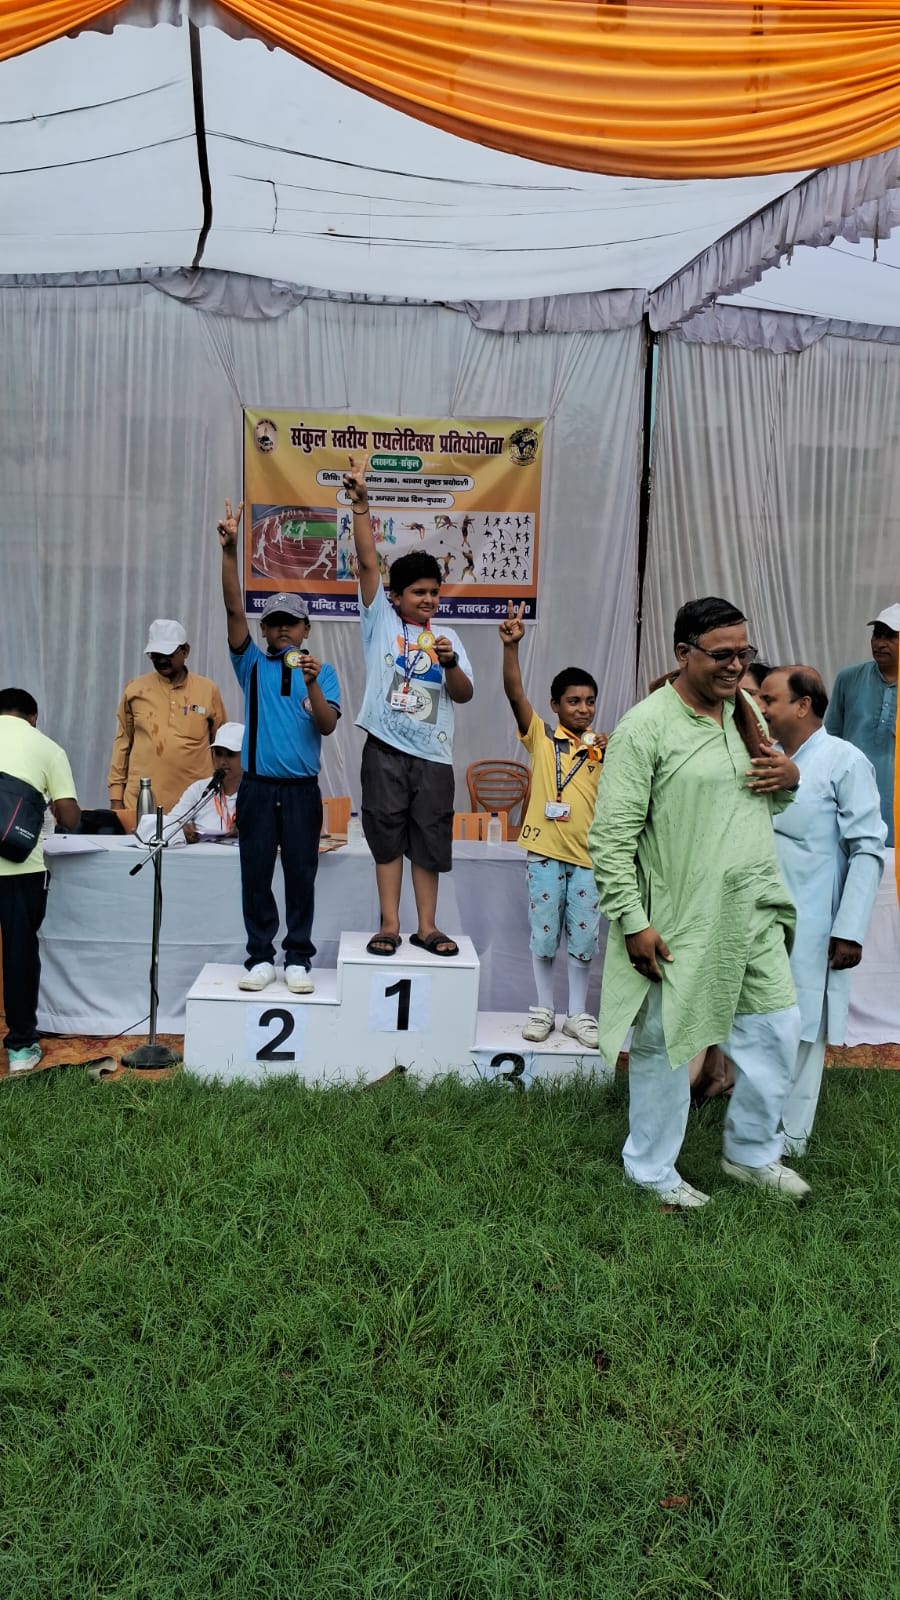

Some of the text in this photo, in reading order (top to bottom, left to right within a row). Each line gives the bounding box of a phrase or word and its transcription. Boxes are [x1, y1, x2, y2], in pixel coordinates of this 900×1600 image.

[290, 422, 327, 453] संकुल
[331, 425, 368, 450] स्तरीय
[439, 430, 505, 455] प्रतियोगिता
[385, 978, 411, 1031] 1
[256, 1008, 296, 1062] 2
[490, 1052, 527, 1092] 3
